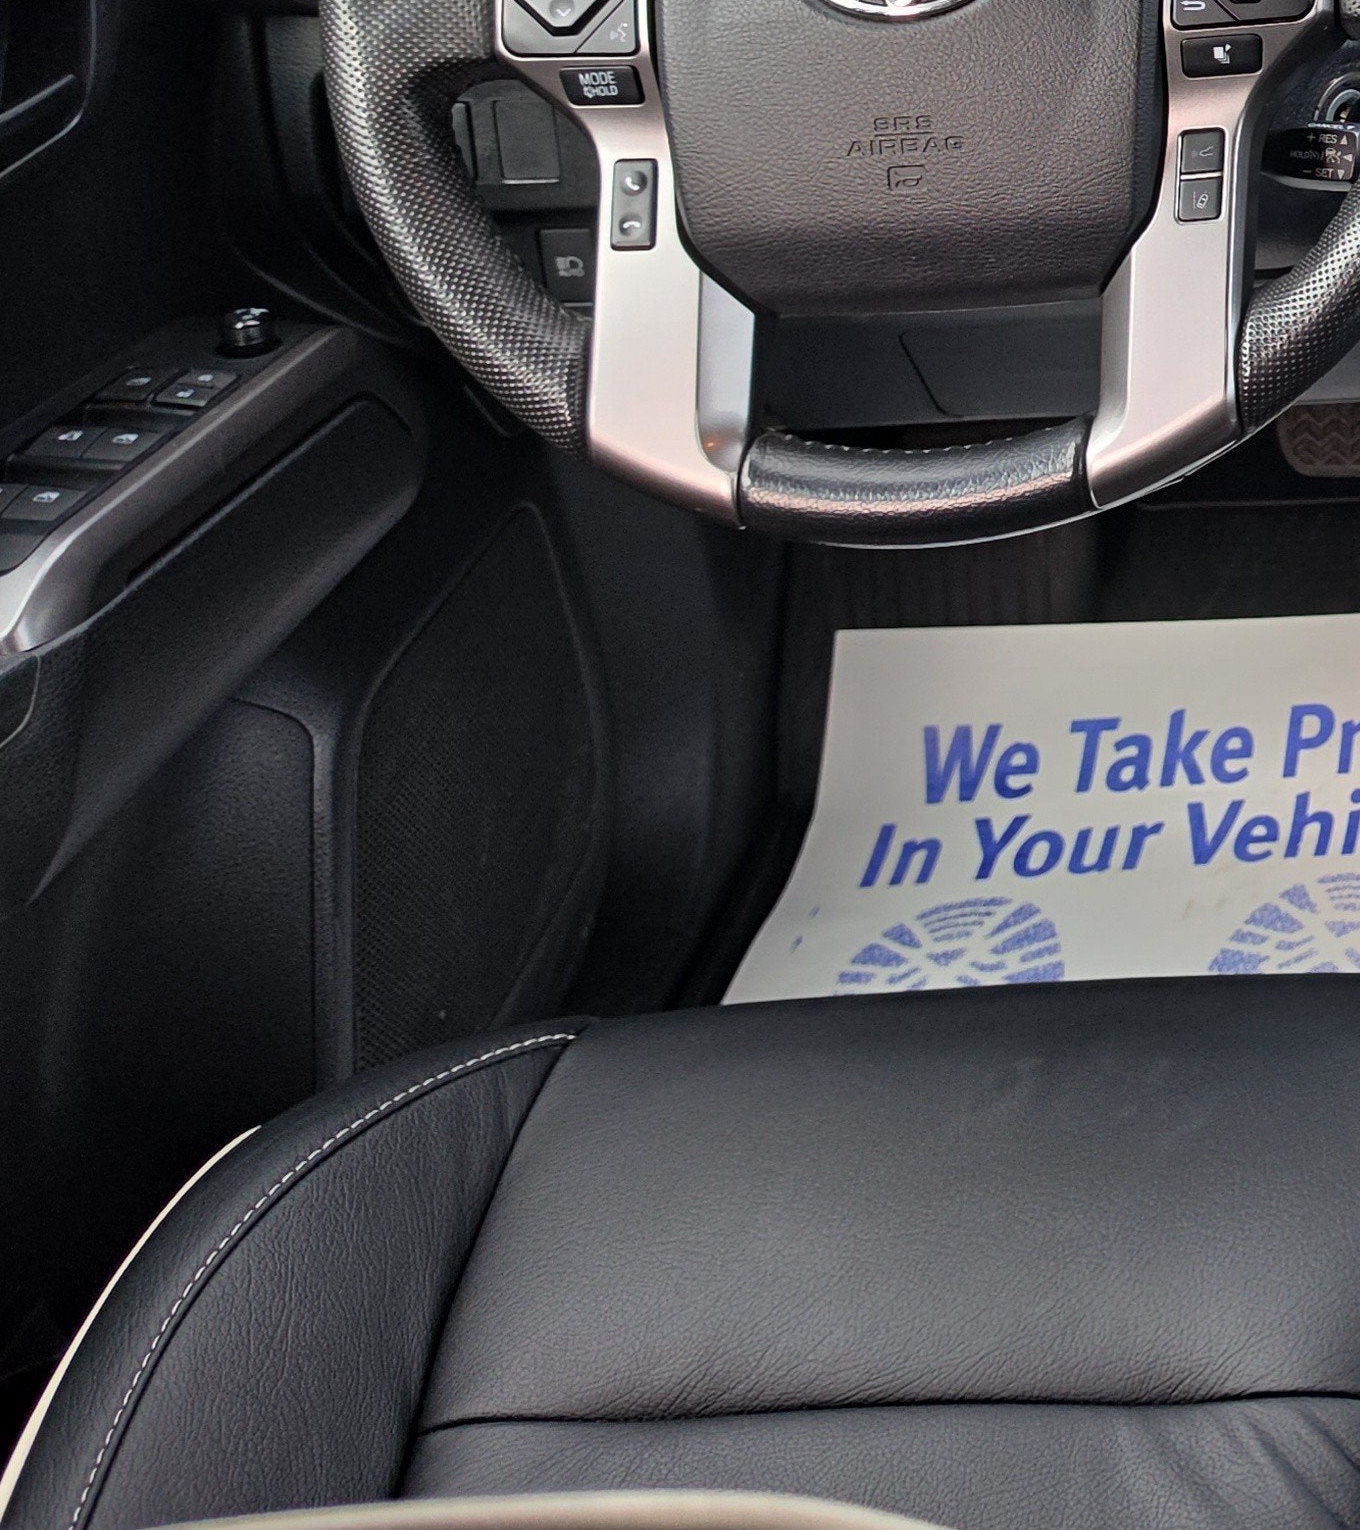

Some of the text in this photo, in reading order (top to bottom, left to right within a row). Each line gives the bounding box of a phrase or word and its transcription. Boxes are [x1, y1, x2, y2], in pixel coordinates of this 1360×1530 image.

[578, 71, 617, 86] MODE
[593, 85, 619, 97] HOLD
[873, 114, 933, 131] SRS
[846, 135, 968, 157] AIRBAG
[1318, 133, 1338, 145] RES
[1315, 167, 1334, 178] SET
[923, 720, 1041, 806] We
[1069, 707, 1255, 795] Take
[858, 821, 940, 889] In
[973, 813, 1164, 882] Your
